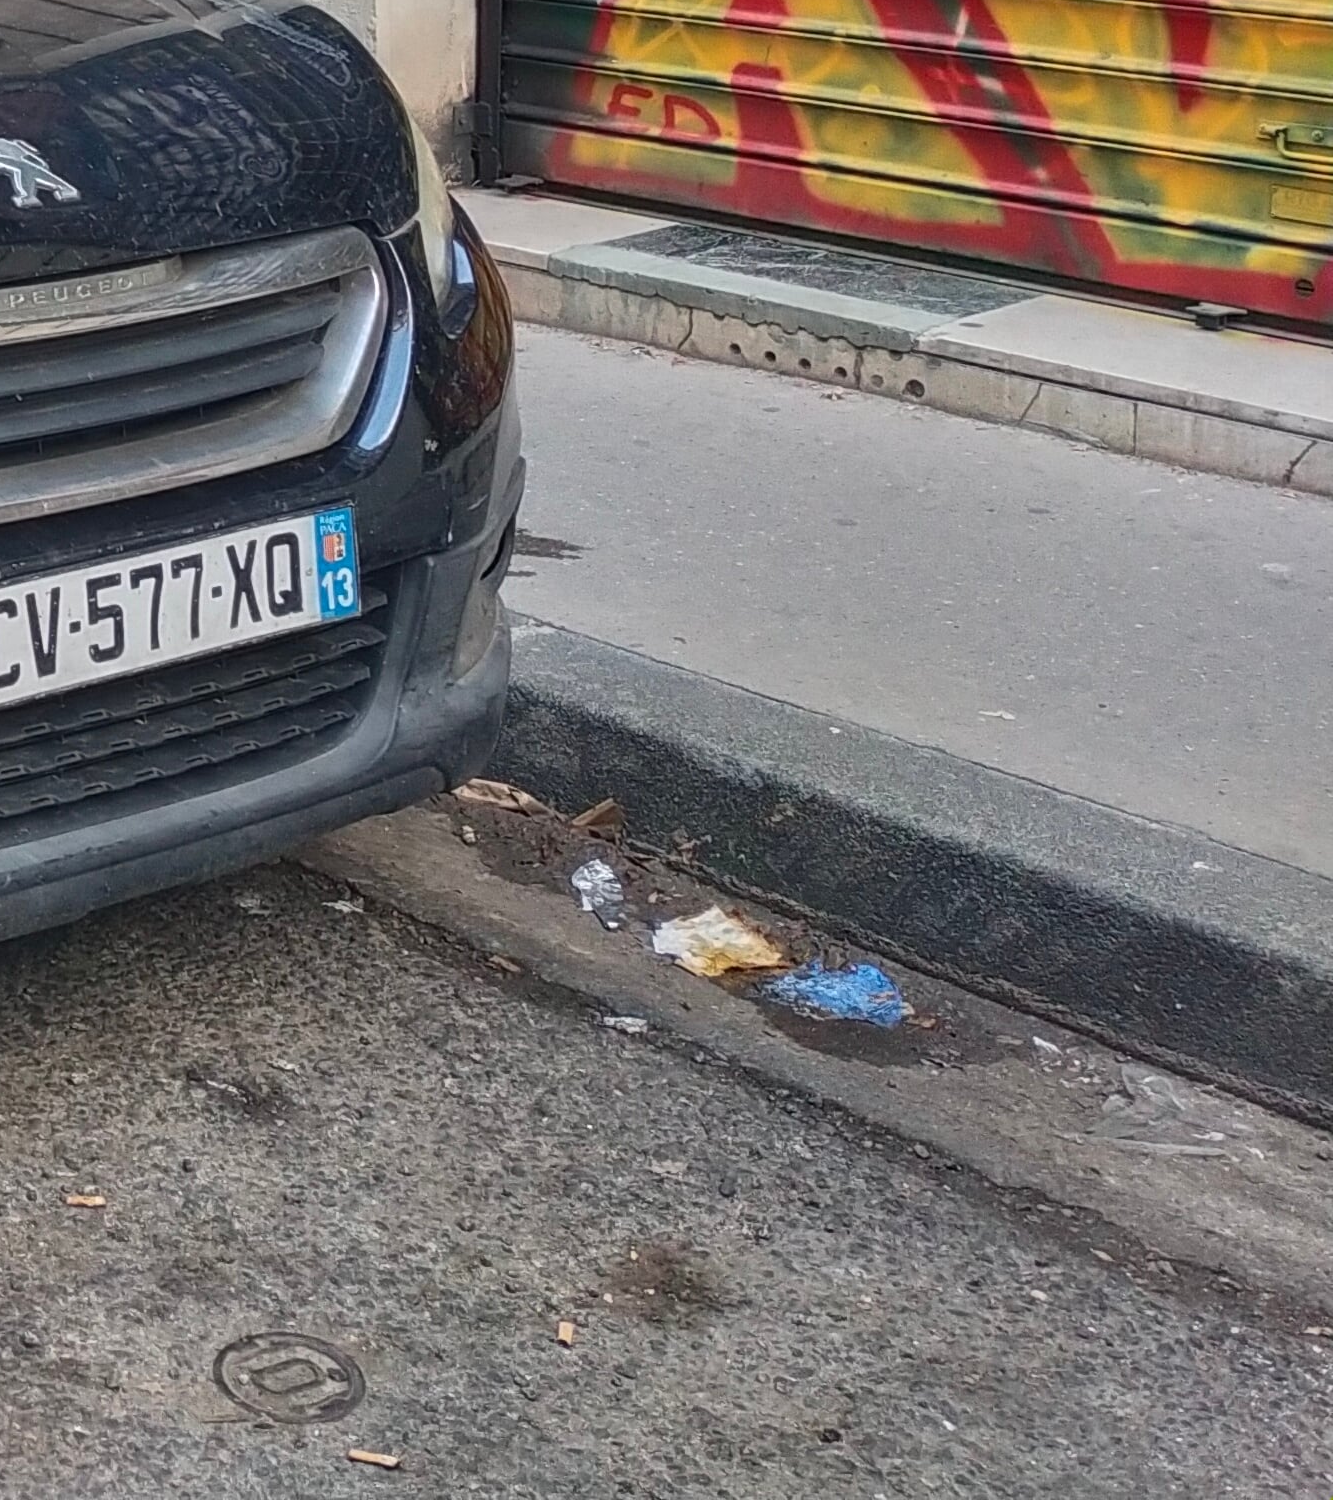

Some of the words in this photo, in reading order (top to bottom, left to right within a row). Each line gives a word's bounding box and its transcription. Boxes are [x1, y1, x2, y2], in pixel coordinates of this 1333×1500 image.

[8, 271, 154, 309] PEUGEOT
[319, 522, 347, 536] PACA
[321, 567, 354, 610] 13
